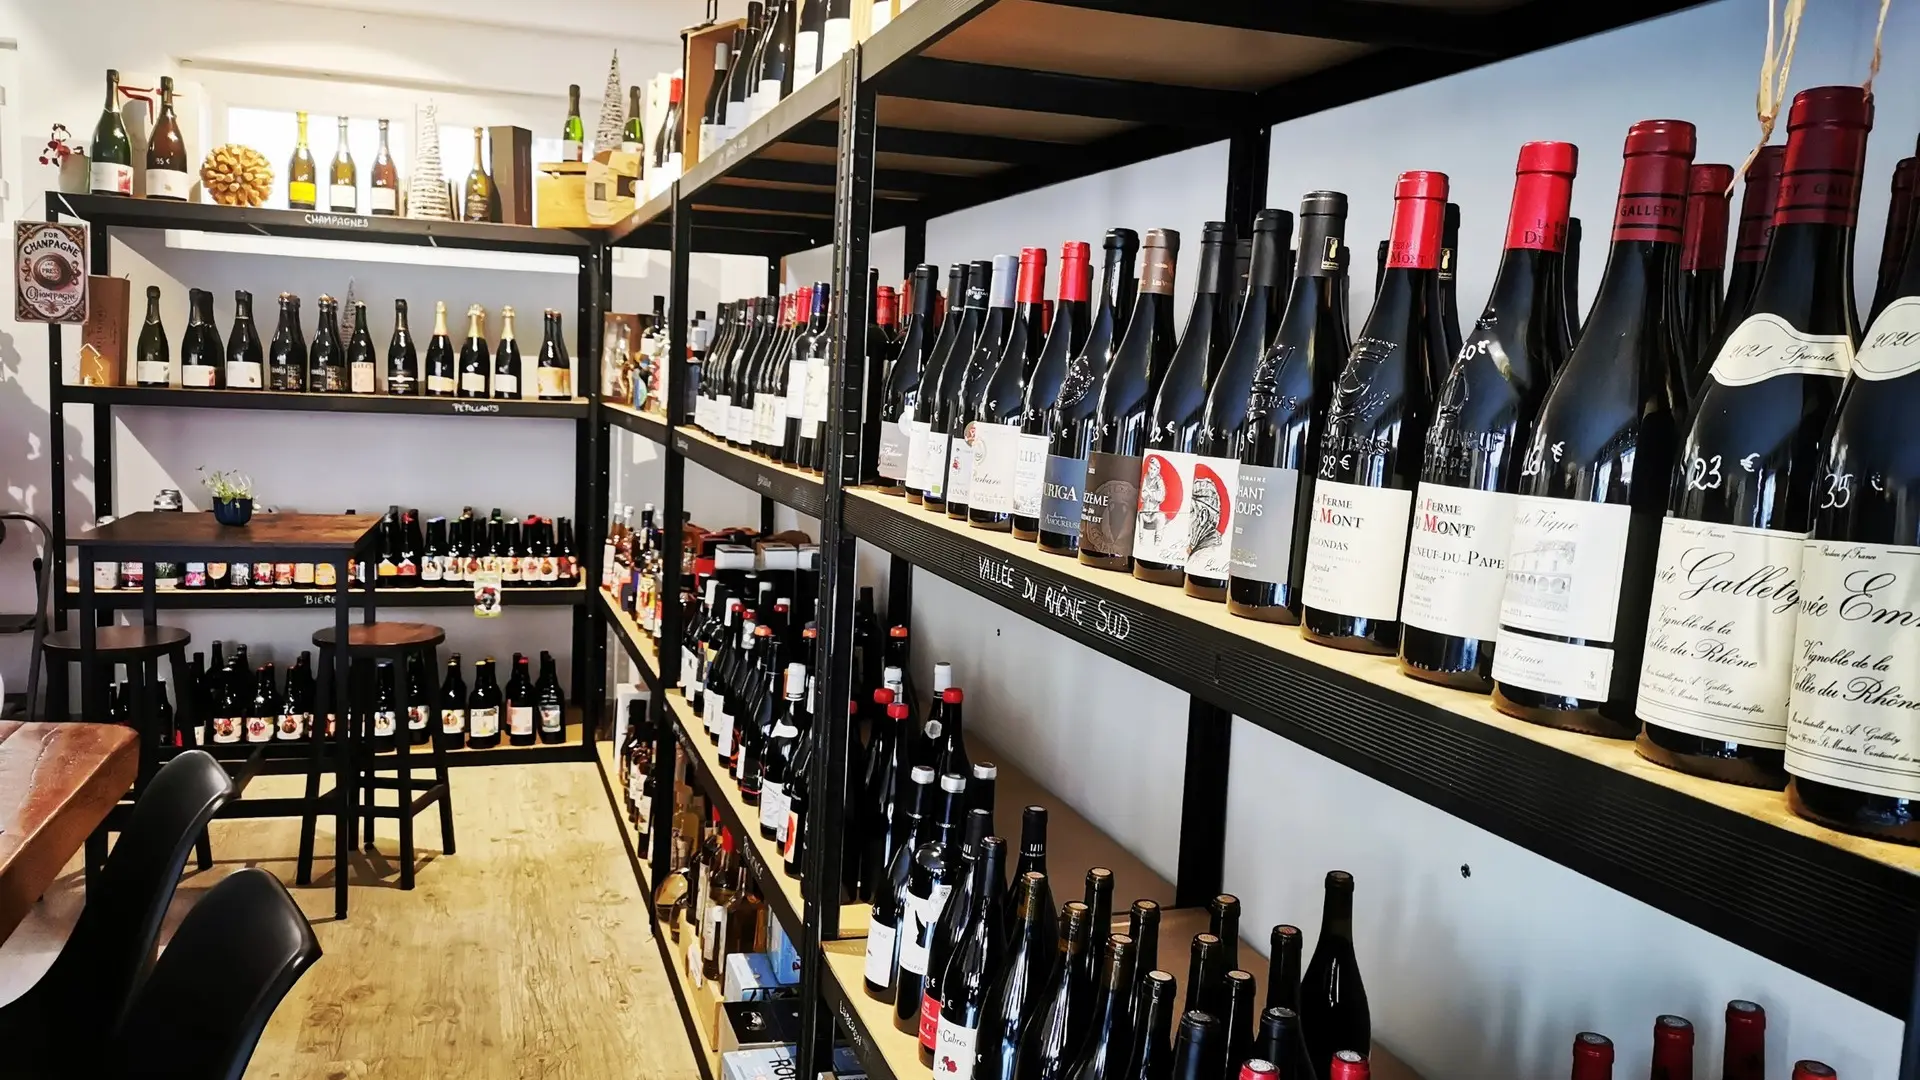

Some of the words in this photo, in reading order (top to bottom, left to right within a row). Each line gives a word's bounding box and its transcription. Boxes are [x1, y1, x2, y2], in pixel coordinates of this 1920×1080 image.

[304, 213, 369, 228] CHAMPAGNES
[1620, 205, 1677, 217] GALLETY
[43, 231, 59, 239] FOR
[1728, 344, 1773, 359] 2021
[1871, 330, 1920, 349] 2020
[1688, 455, 1722, 491] 23
[1740, 453, 1761, 473] €
[1322, 493, 1353, 509] FERME
[1820, 474, 1854, 510] 35
[1320, 507, 1364, 529] MONT
[1425, 498, 1462, 516] FERME
[1423, 513, 1476, 539] MONT
[1850, 546, 1877, 560] France
[1678, 547, 1800, 614] Gallety
[978, 558, 1016, 589] VALLÉE
[1021, 575, 1039, 603] DU
[1044, 584, 1087, 626] RHÔNE
[1095, 599, 1131, 641] SUD
[1659, 604, 1704, 629] Vignoble
[1700, 620, 1716, 633] de
[1717, 620, 1735, 636] la
[1647, 627, 1669, 652] Vallée
[1669, 641, 1688, 657] du
[1690, 638, 1758, 669] Rhône
[1802, 639, 1855, 669] Vignoble
[1851, 650, 1869, 670] de
[1873, 652, 1894, 673] la
[1791, 664, 1817, 695] Vallée
[1817, 680, 1839, 699] du
[1842, 676, 1920, 711] Rhône
